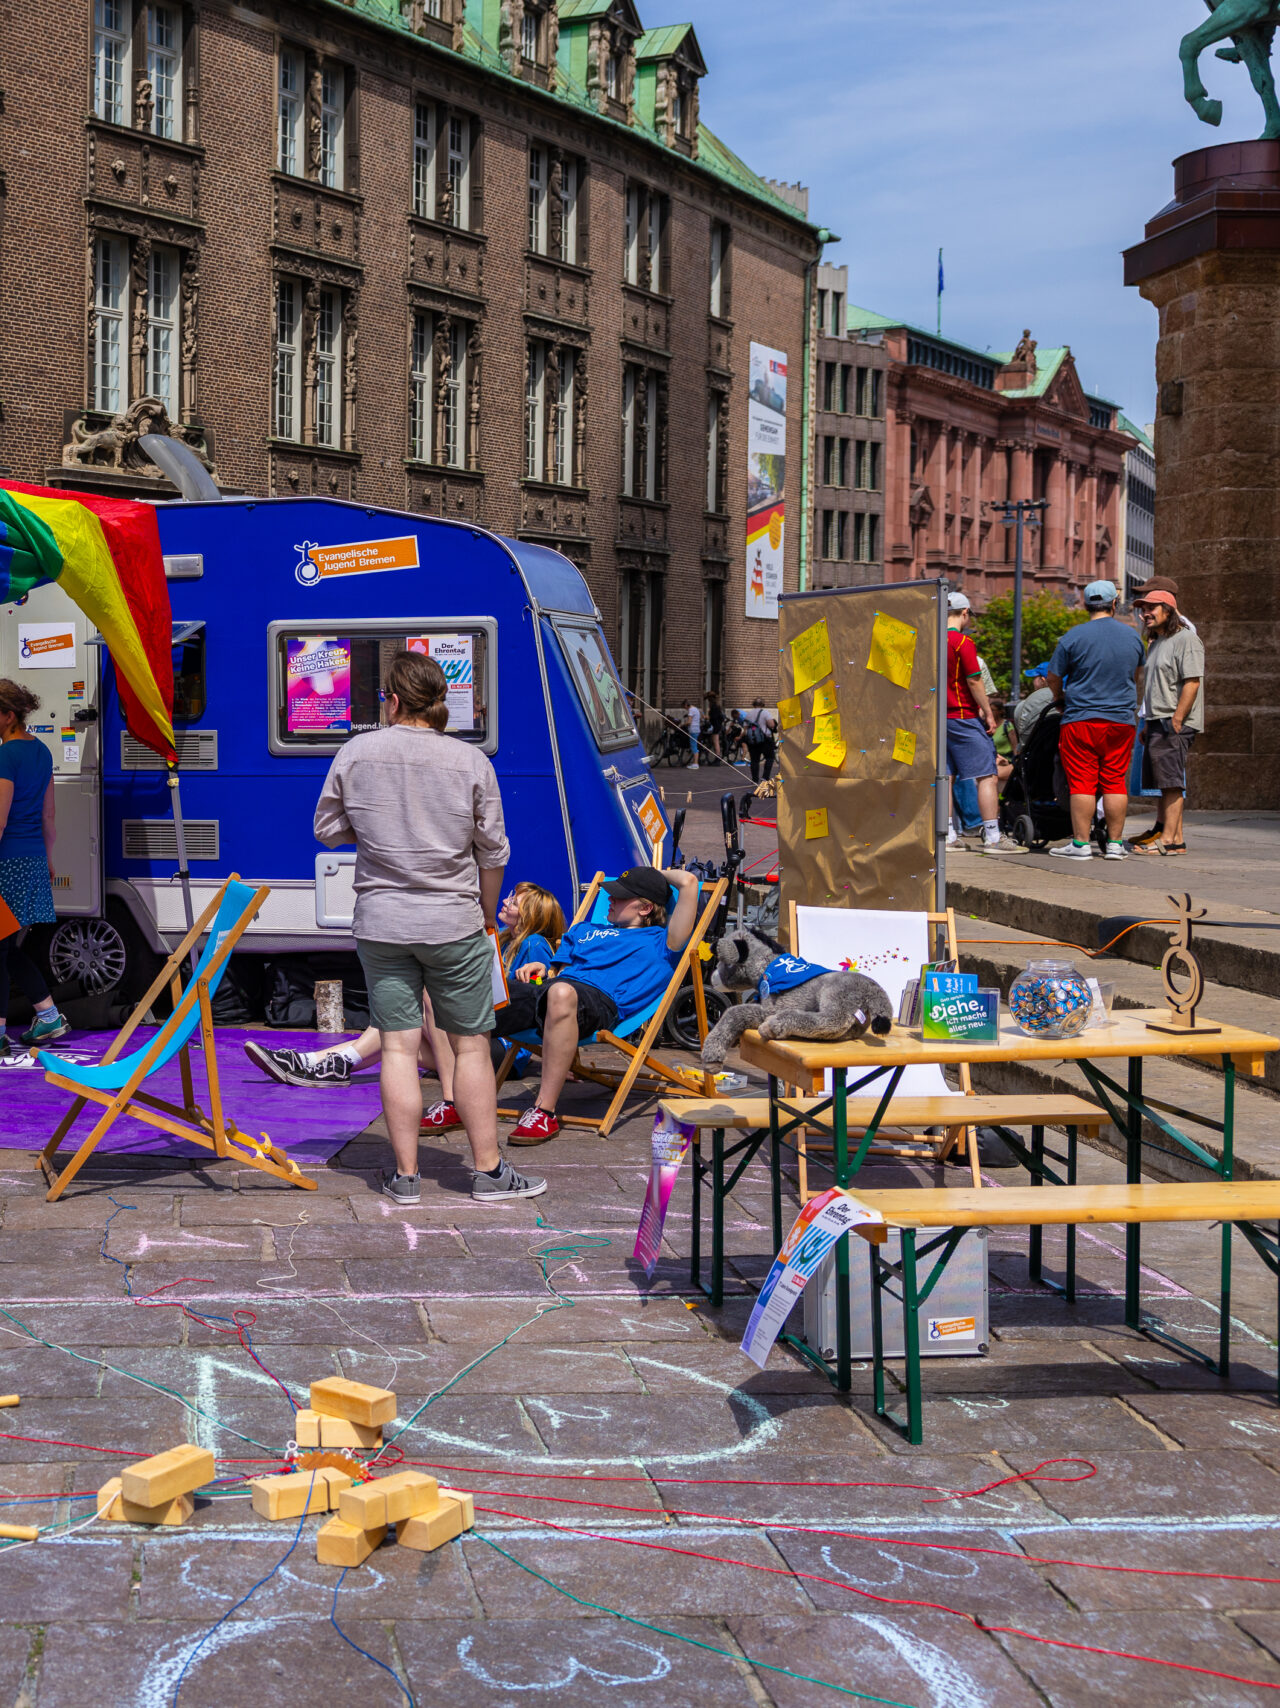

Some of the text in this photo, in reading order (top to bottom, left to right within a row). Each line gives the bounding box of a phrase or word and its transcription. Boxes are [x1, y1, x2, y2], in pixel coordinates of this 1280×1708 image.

[318, 547, 378, 561] Evangelische
[324, 555, 396, 571] Jugend Bremen
[290, 647, 348, 664] Unser Kreuz.
[290, 662, 316, 674] Keine
[317, 657, 349, 668] Haken.
[930, 999, 984, 1023] Siehe,
[946, 1011, 987, 1025] ich mache
[949, 1021, 986, 1033] alles neu.
[824, 1206, 853, 1225] Ehrentag
[837, 1203, 851, 1214] Der
